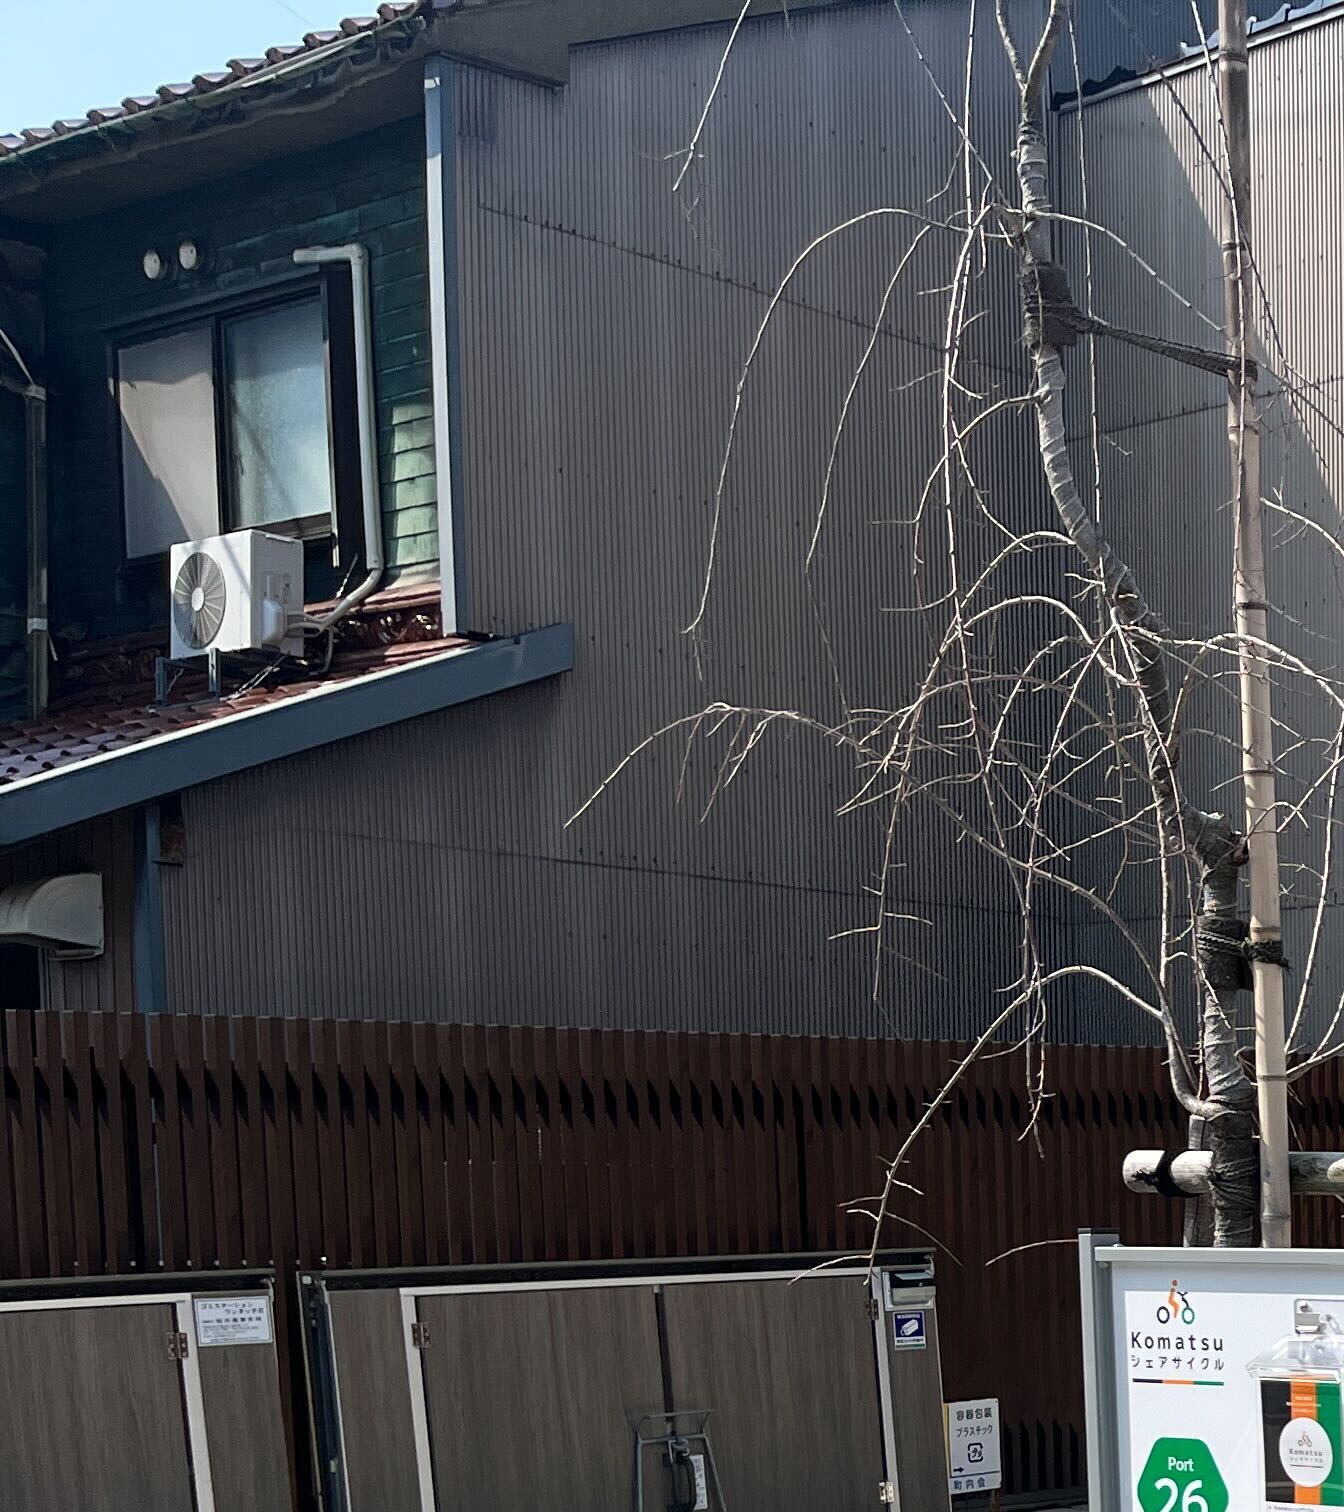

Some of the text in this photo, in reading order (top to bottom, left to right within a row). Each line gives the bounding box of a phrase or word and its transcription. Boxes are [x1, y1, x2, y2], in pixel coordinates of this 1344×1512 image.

[1131, 1331, 1224, 1352] Komatsu
[1131, 1354, 1225, 1372] シェアサイクル
[956, 1407, 993, 1422] 容器包装
[956, 1424, 993, 1438] プラスチック
[1167, 1456, 1194, 1472] Port
[953, 1476, 986, 1491] 町内会
